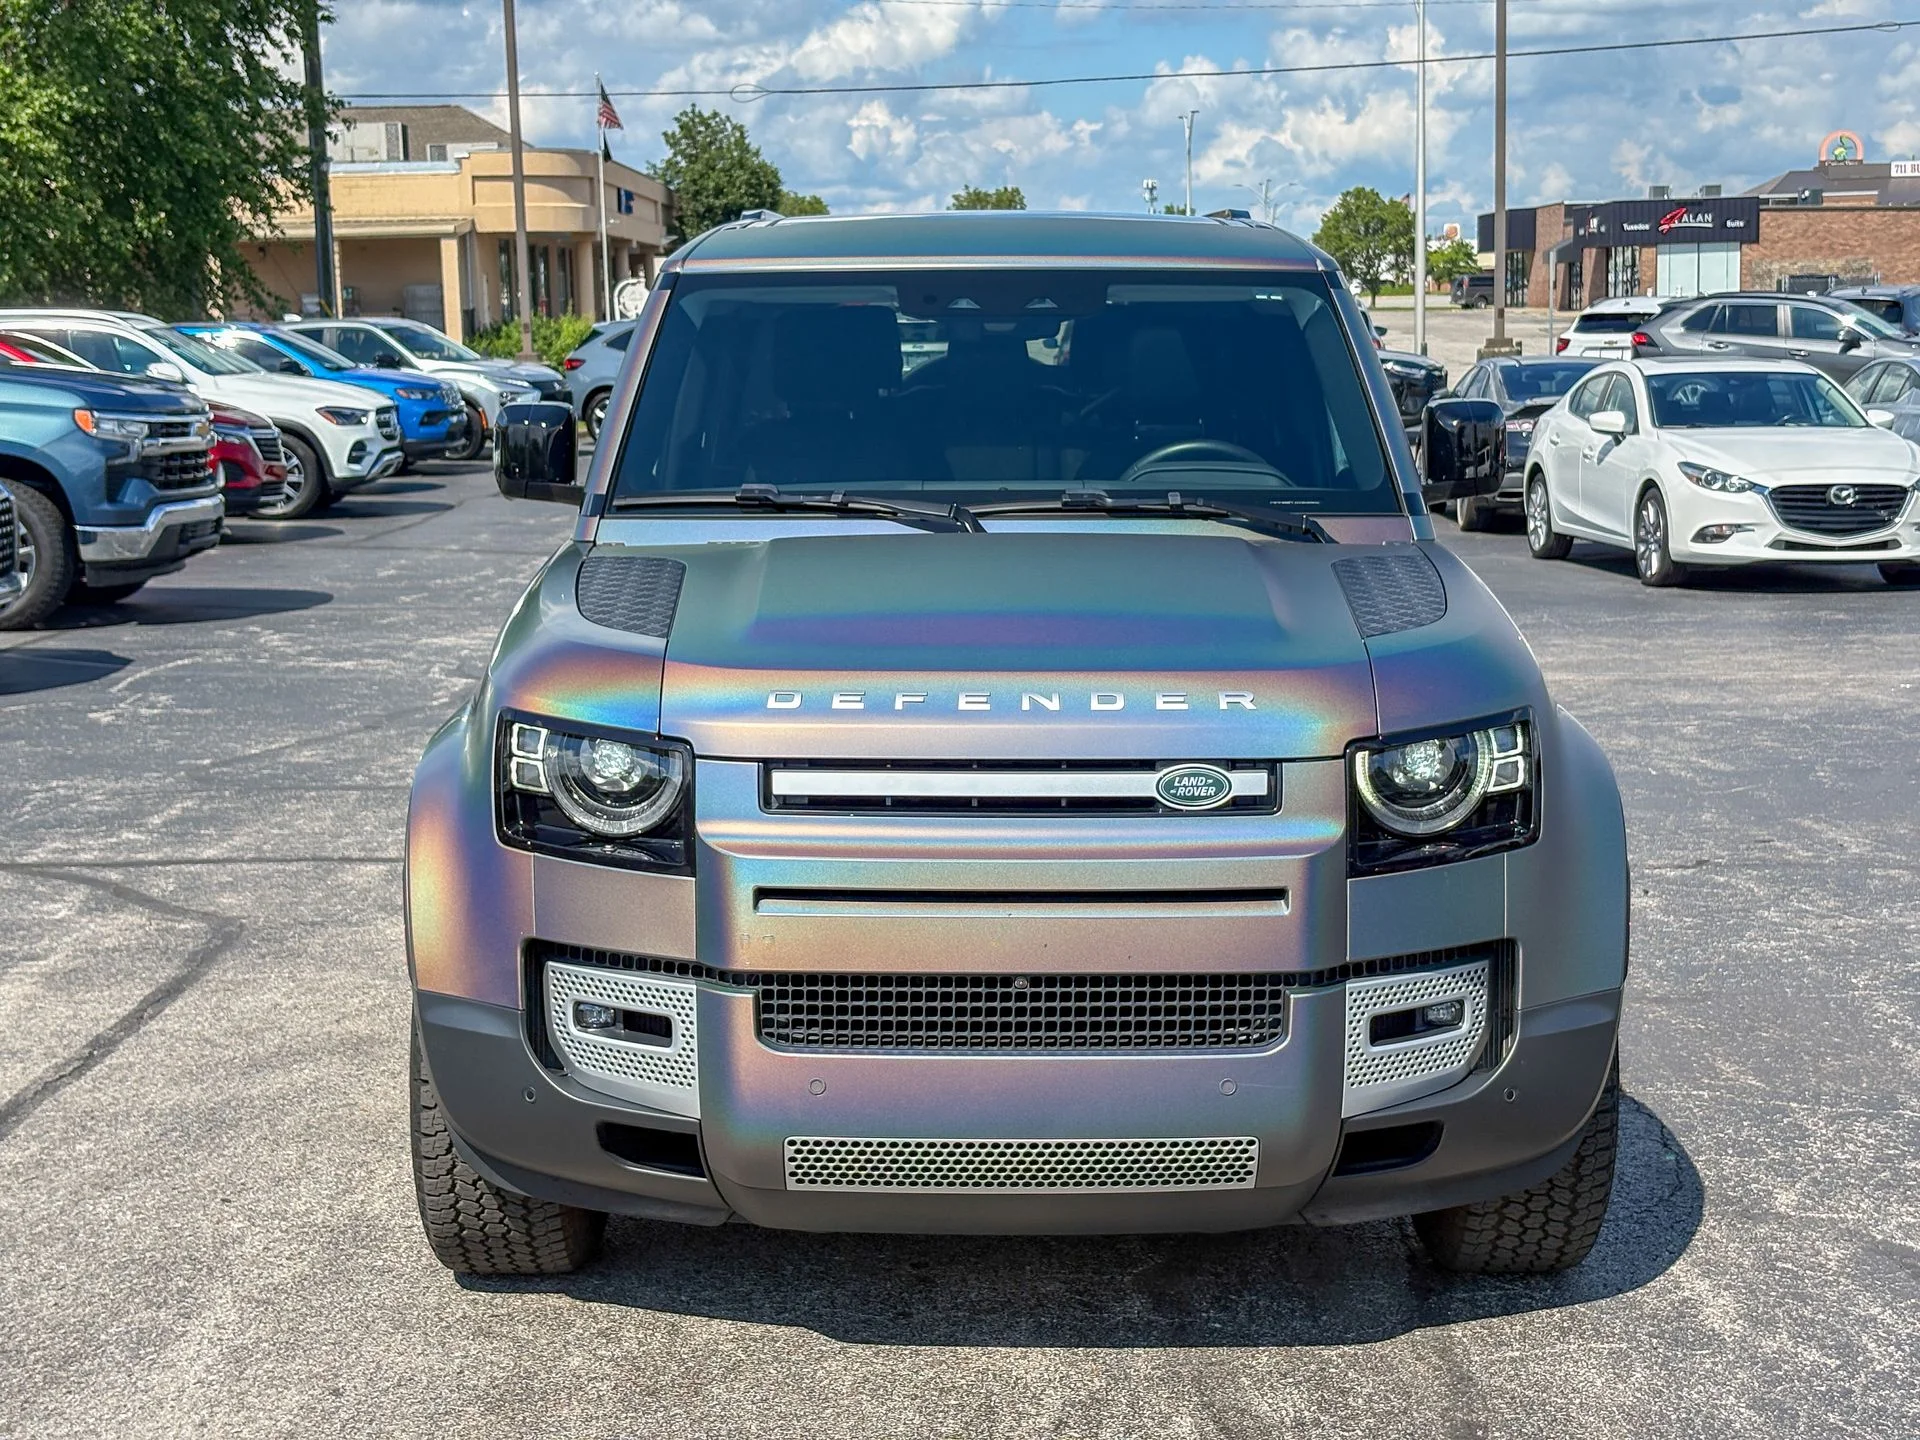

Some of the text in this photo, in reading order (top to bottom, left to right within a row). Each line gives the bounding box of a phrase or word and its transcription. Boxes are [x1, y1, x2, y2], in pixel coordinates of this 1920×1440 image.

[766, 690, 1258, 711] DEFENDER
[1174, 776, 1206, 786] LAND
[1176, 786, 1216, 796] ROVER
